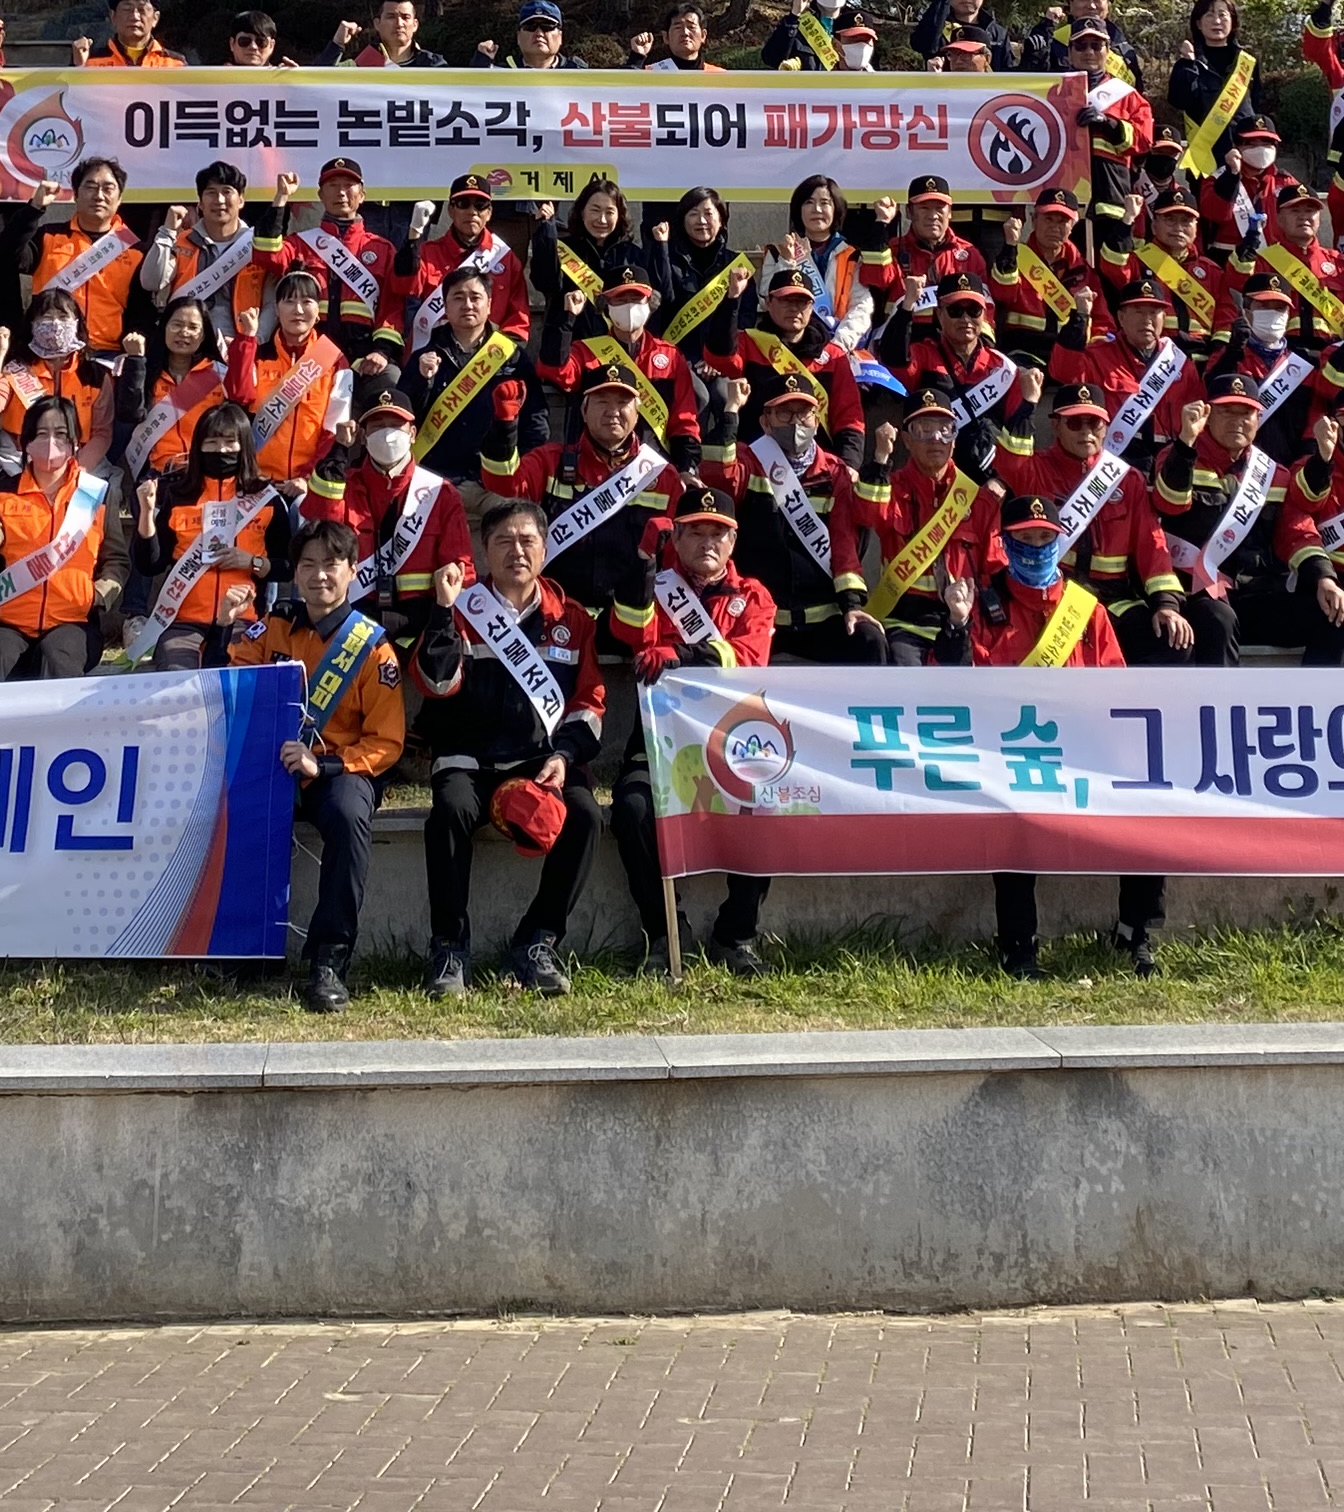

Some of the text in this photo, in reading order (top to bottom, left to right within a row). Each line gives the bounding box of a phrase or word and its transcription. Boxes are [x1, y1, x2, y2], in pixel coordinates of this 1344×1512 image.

[124, 99, 949, 153] 이득없는 논밭소각, 산불되어 패가망신
[1043, 281, 1072, 312] 산불
[257, 358, 323, 439] 산불조심
[430, 360, 492, 430] 산불조심
[1120, 358, 1177, 429] 산불조심
[1257, 377, 1291, 413] 산불
[554, 475, 637, 546] 산불조심
[784, 490, 831, 559] 산불조
[1058, 460, 1122, 537] 산불조심
[894, 508, 959, 582] 산불조심
[667, 586, 711, 636] 산불
[486, 614, 563, 718] 산불조심
[846, 705, 982, 792] 푸른
[1000, 704, 1090, 809] 숲,
[1109, 707, 1174, 791] 그
[759, 785, 822, 805] 산불조심
